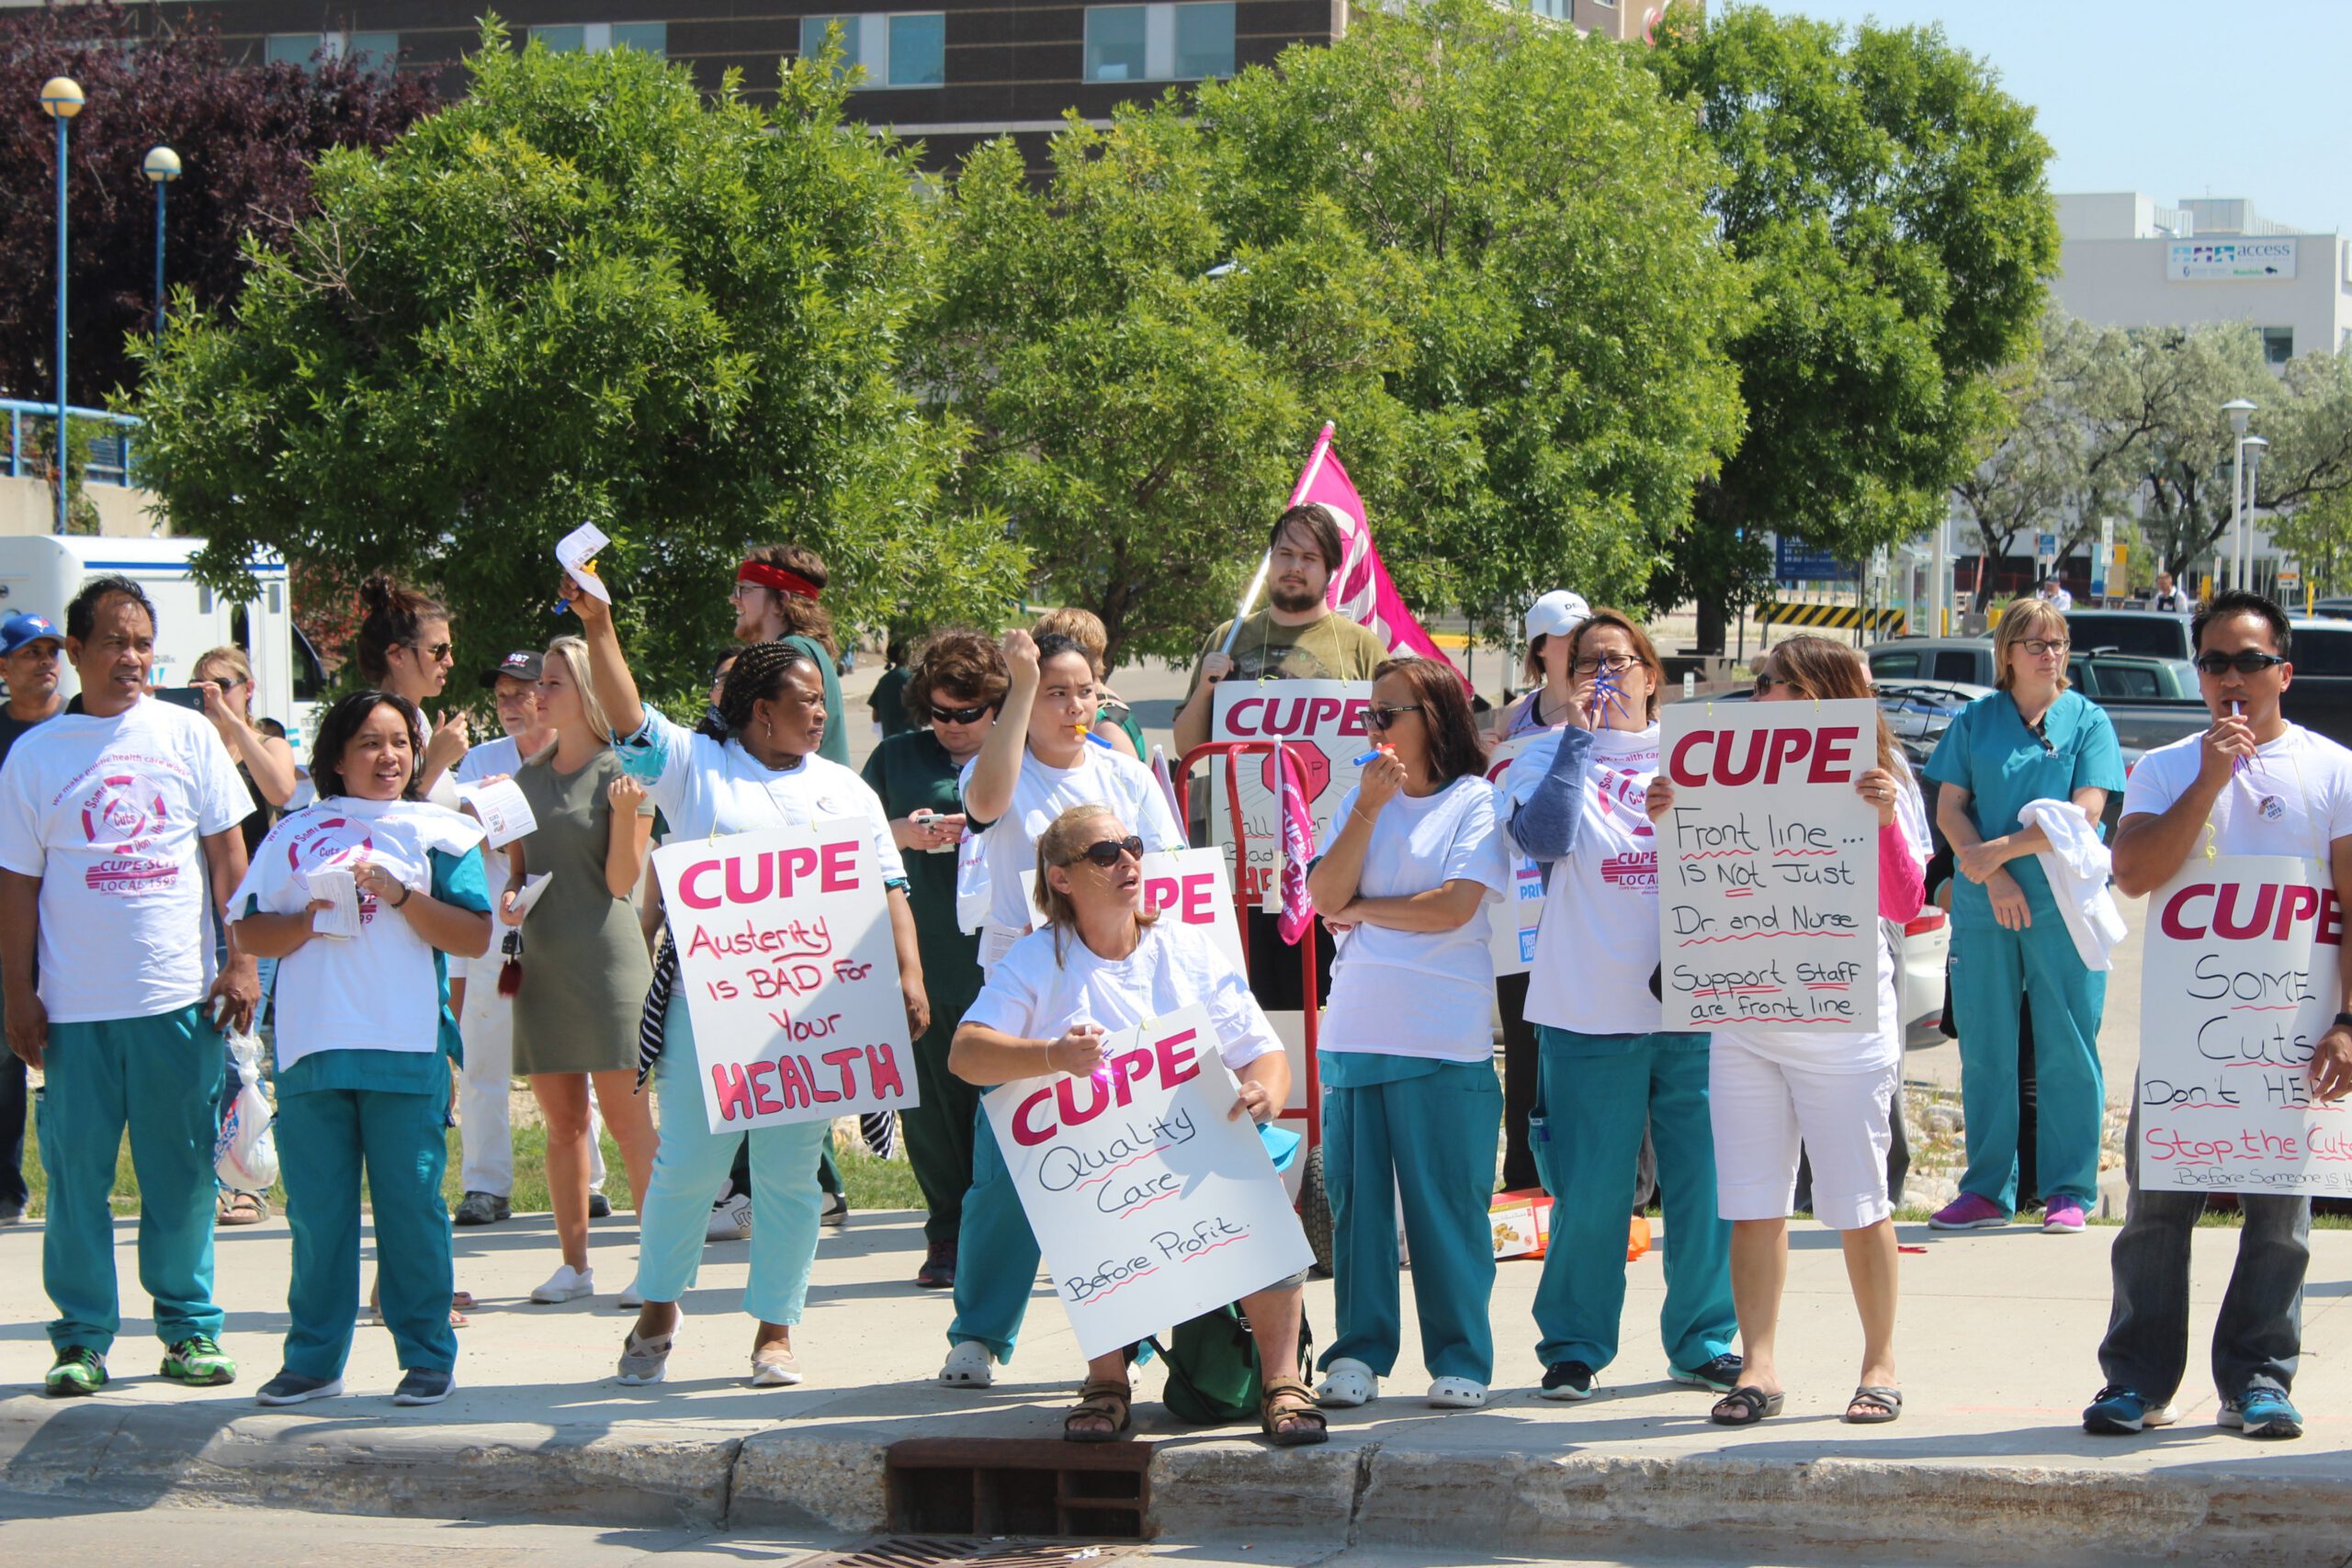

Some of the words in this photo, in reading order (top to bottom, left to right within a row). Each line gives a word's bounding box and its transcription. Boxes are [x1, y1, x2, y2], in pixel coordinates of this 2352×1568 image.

[2237, 243, 2290, 257] access
[1226, 698, 1370, 737] CUPE
[112, 753, 141, 761] health
[144, 757, 164, 766] care
[1669, 727, 1860, 787] CUPE
[85, 785, 107, 809] Some
[1599, 771, 1616, 790] Som
[1629, 790, 1645, 805] Cut
[113, 812, 136, 826] Cuts
[1673, 807, 1759, 852] Front
[320, 847, 340, 857] Cuts
[679, 840, 859, 909] CUPE
[1771, 861, 1855, 885] Just
[1144, 873, 1215, 925] PE
[2161, 883, 2342, 946] CUPE
[1672, 905, 1718, 934] Dr.
[1730, 905, 1780, 930] and
[1792, 905, 1859, 931] Nurse
[687, 915, 832, 964] Austerity
[746, 964, 822, 999] BAD
[1672, 959, 1787, 1000] Support
[1796, 962, 1861, 983] Staff
[768, 1009, 842, 1043] Your
[1690, 1000, 1726, 1019] are
[2198, 1016, 2316, 1065] Cuts
[712, 1043, 904, 1121] HEALTH
[1012, 1027, 1201, 1146] CUPE
[2143, 1074, 2240, 1105] Don't
[2146, 1128, 2233, 1164] Stop
[2240, 1129, 2298, 1155] the
[1097, 1171, 1181, 1213] Care
[2173, 1167, 2245, 1186] Before
[2249, 1168, 2321, 1184] Someone
[1065, 1256, 1152, 1303] Before
